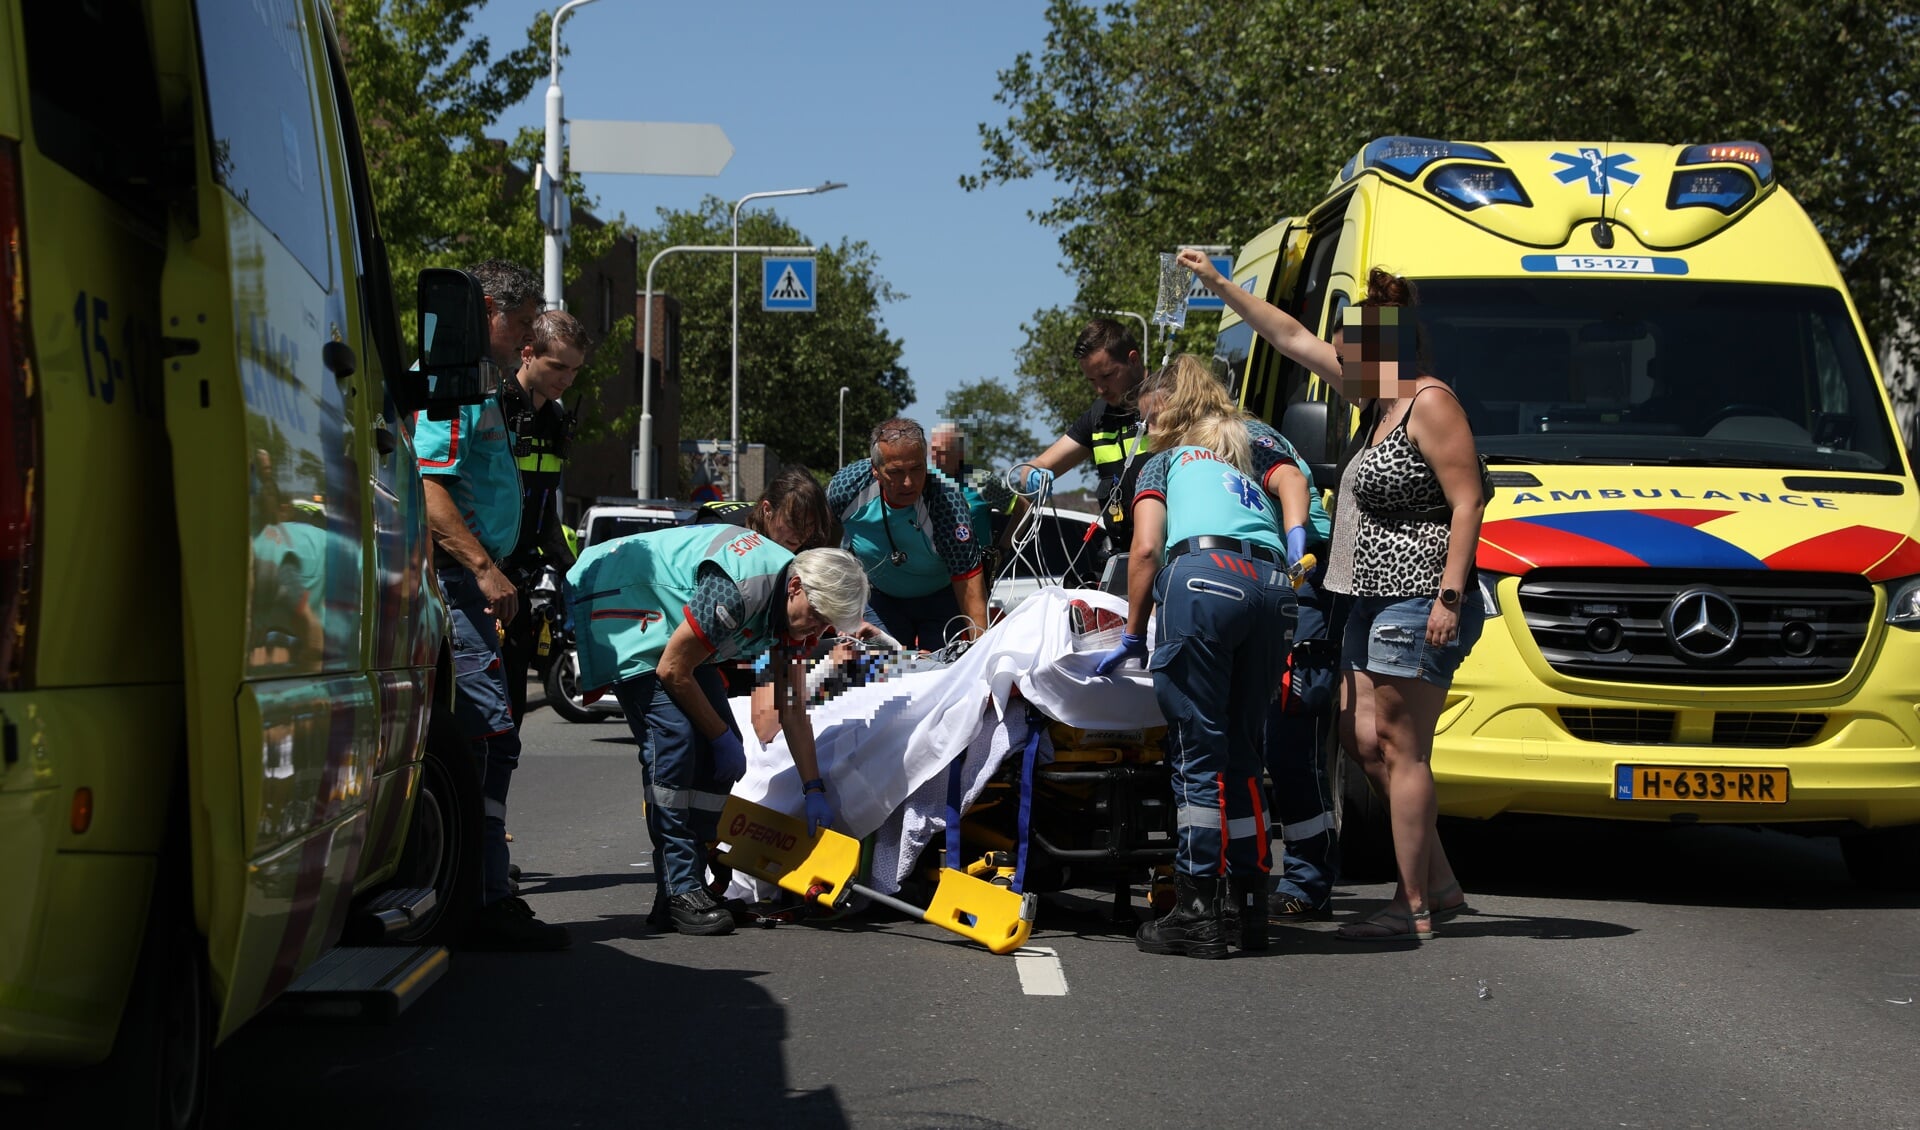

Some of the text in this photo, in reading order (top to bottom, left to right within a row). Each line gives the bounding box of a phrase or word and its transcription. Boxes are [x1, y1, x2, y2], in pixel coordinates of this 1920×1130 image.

[1570, 257, 1640, 270] 15-127
[1512, 488, 1840, 511] AMBULANCE
[1619, 785, 1631, 794] NL
[1642, 770, 1776, 800] H-633-RR
[742, 821, 798, 852] FERNO
